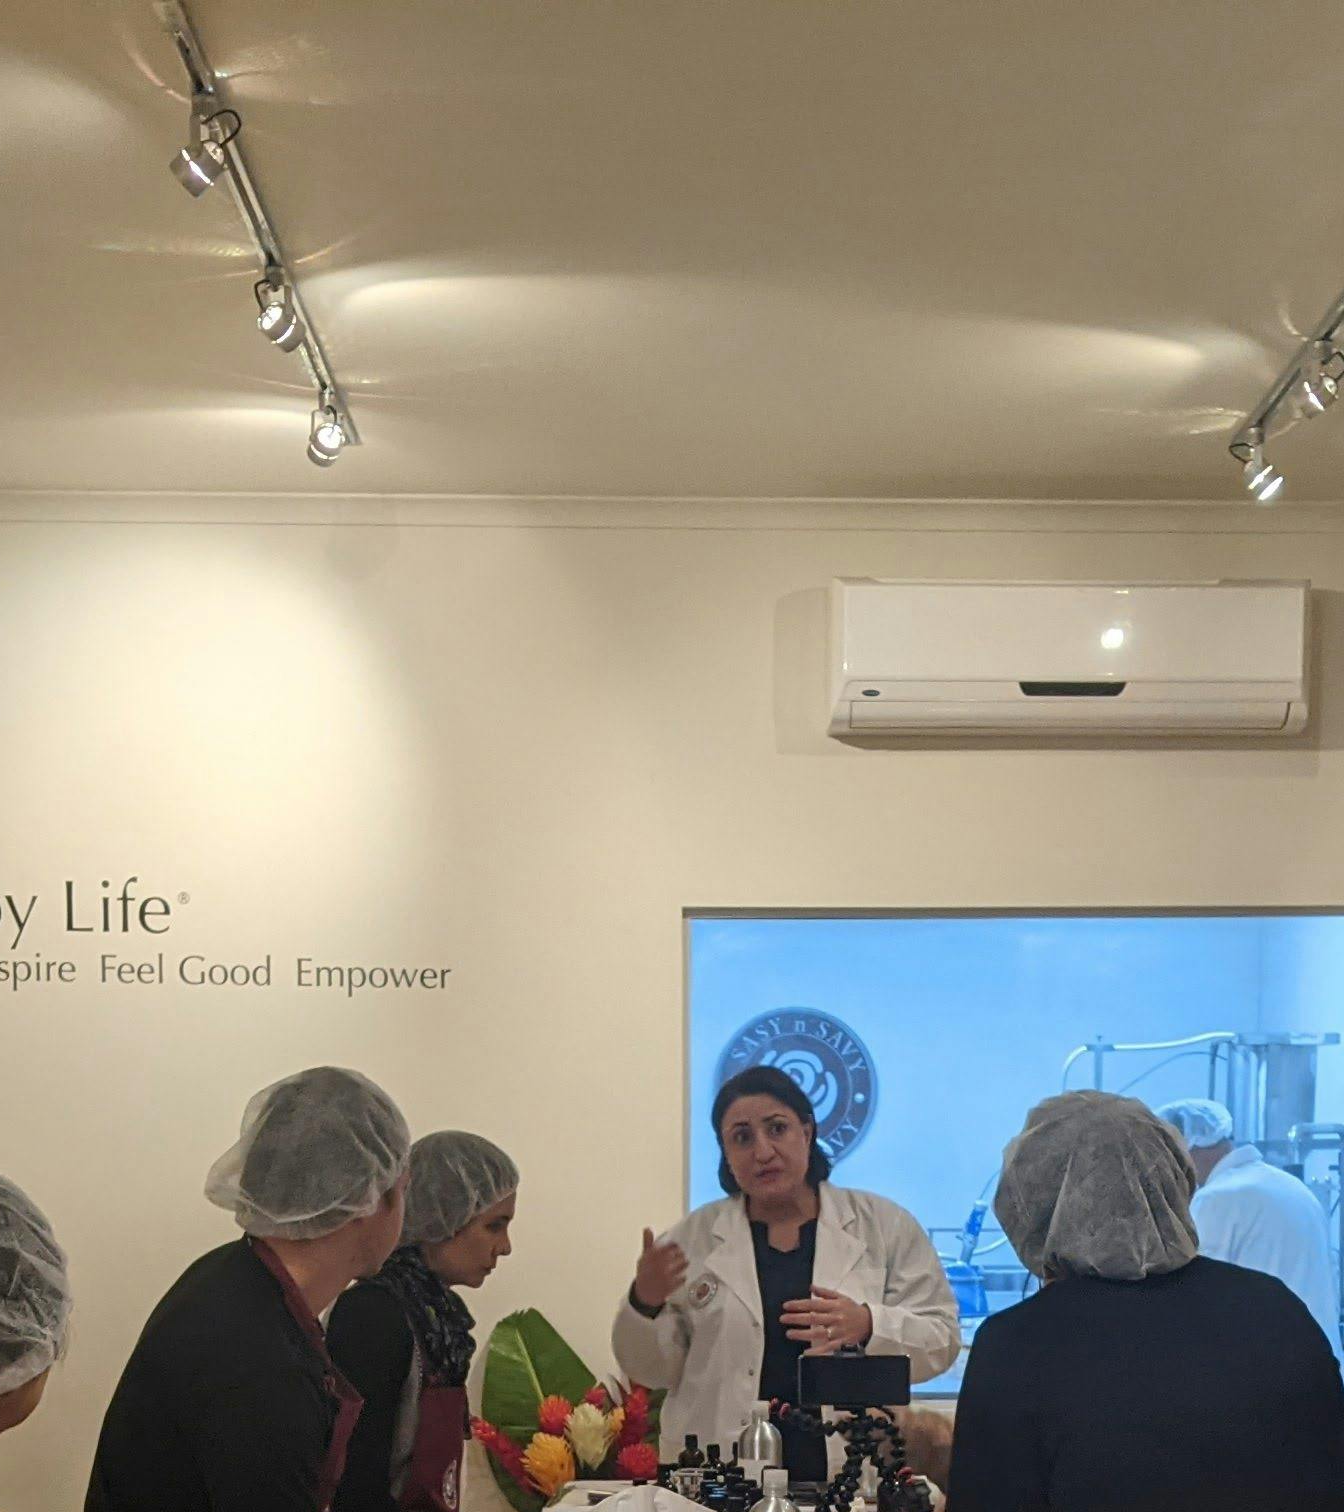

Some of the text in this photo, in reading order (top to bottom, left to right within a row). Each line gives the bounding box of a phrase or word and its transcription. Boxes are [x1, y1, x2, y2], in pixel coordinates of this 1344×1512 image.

[99, 953, 164, 985] Feel
[179, 955, 272, 988] Good
[296, 957, 452, 998] Empower
[731, 1017, 781, 1060] SASY
[816, 1021, 866, 1073] SAVY
